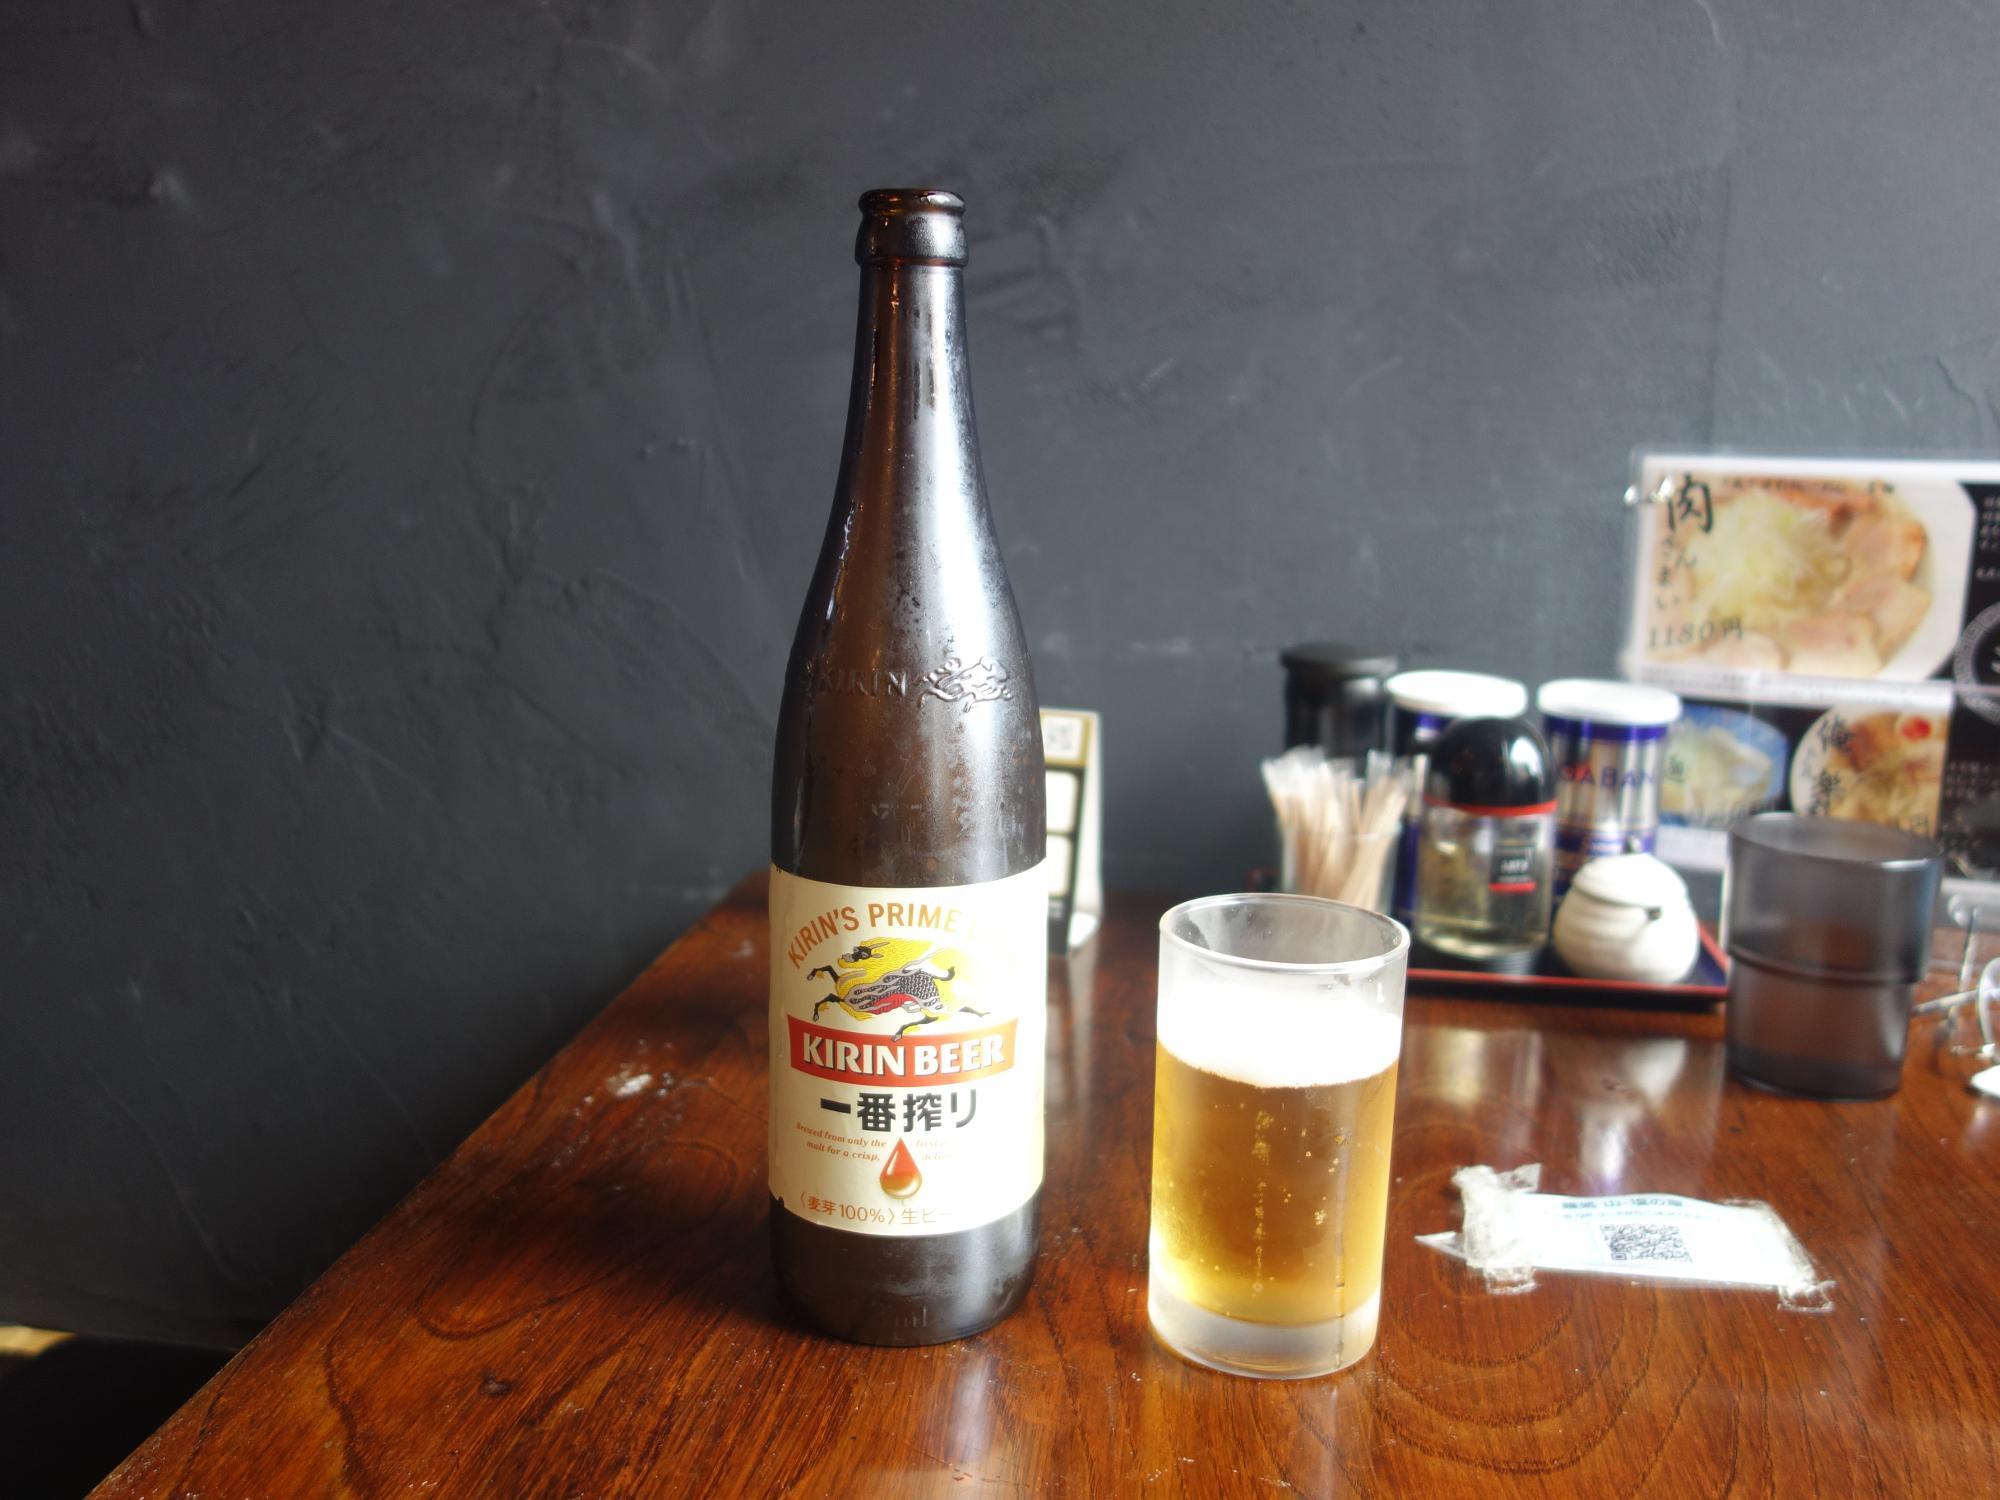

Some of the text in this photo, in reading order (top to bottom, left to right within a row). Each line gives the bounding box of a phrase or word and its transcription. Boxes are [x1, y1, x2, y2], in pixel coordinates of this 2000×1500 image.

[787, 906, 860, 970] KIRIN'S
[868, 903, 960, 933] PRIME
[802, 1032, 1007, 1077] KIRIN BEER
[820, 1088, 977, 1133] 一番搾り
[806, 1141, 824, 1152] malt
[826, 1145, 841, 1156] for
[823, 1131, 845, 1143] from
[847, 1137, 868, 1148] only
[871, 1139, 887, 1148] the
